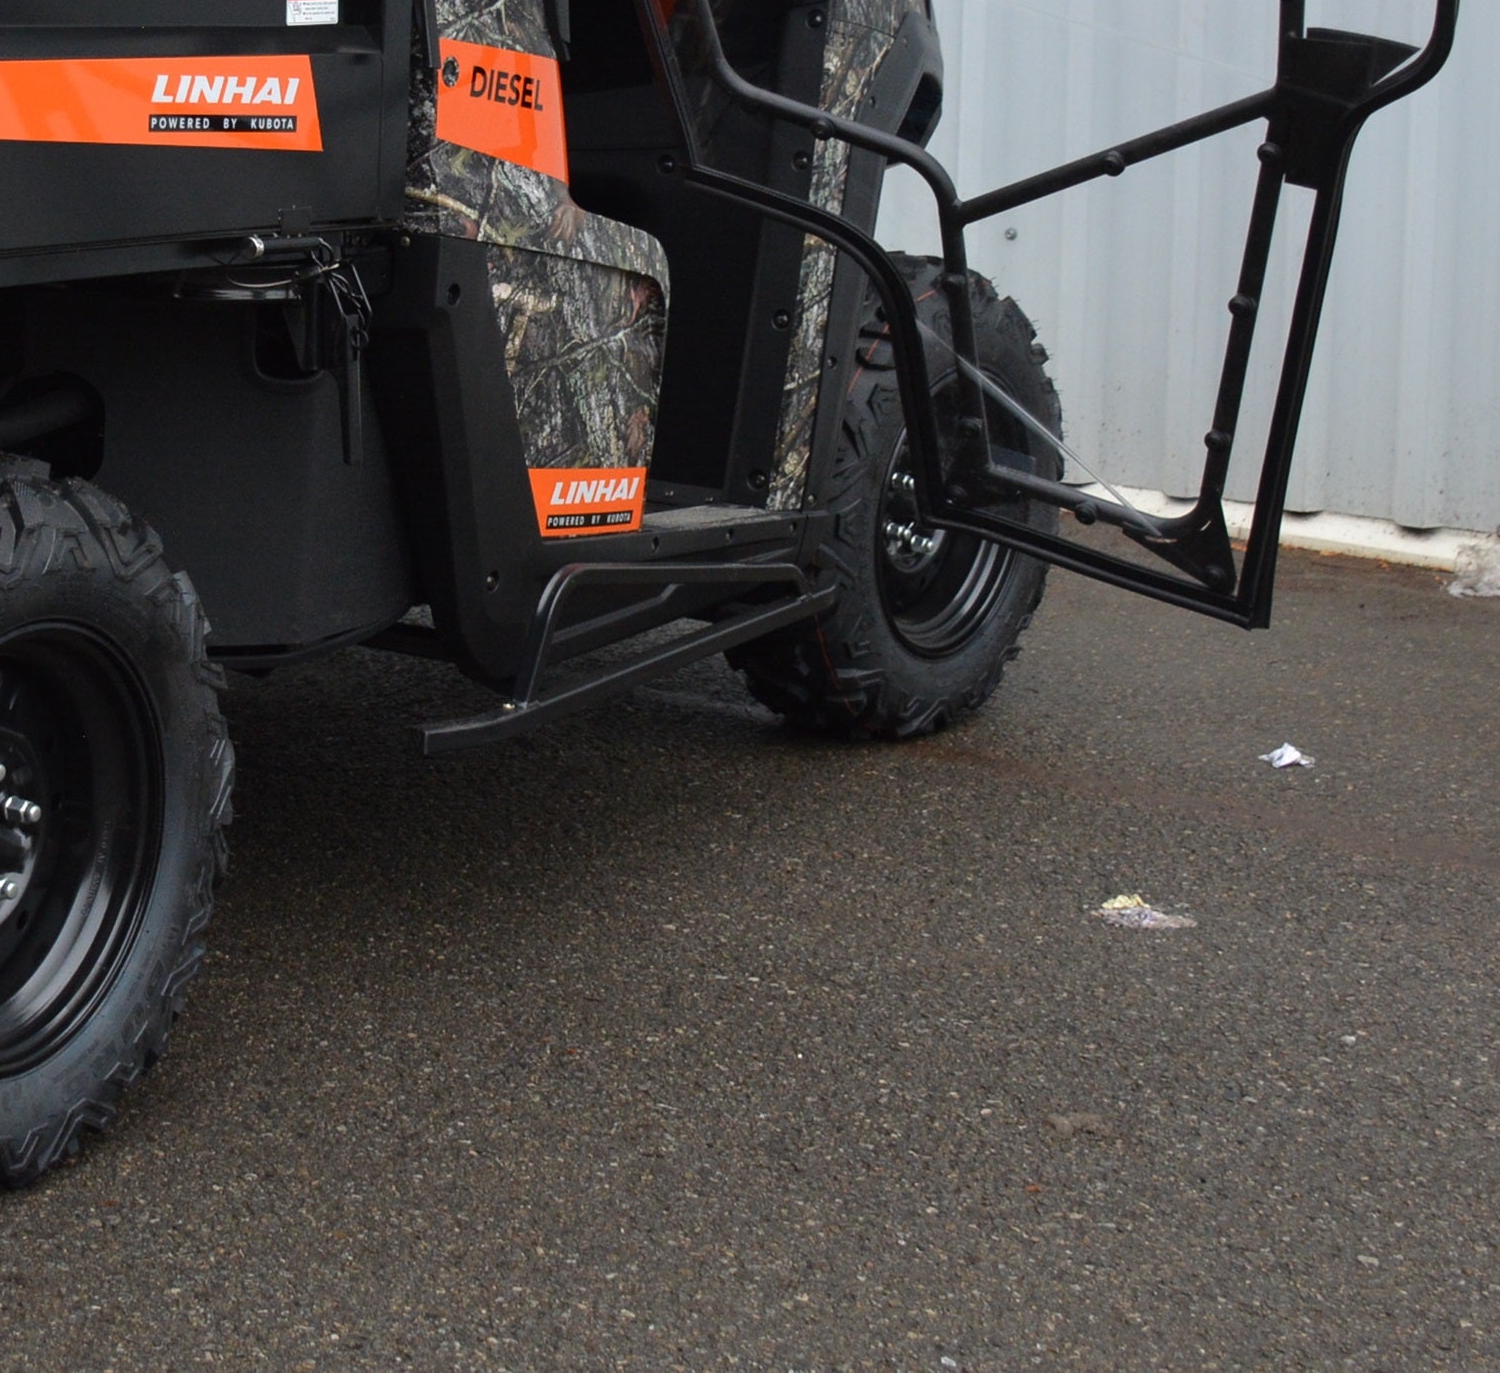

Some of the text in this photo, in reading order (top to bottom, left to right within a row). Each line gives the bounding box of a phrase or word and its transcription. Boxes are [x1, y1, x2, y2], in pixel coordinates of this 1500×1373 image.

[151, 74, 300, 104] LINHAI
[470, 65, 543, 111] DIESEL
[151, 117, 294, 130] POWERED BY KUBOTA
[550, 477, 640, 505] LINHAI
[548, 512, 631, 527] POWERED BY KUBOTA
